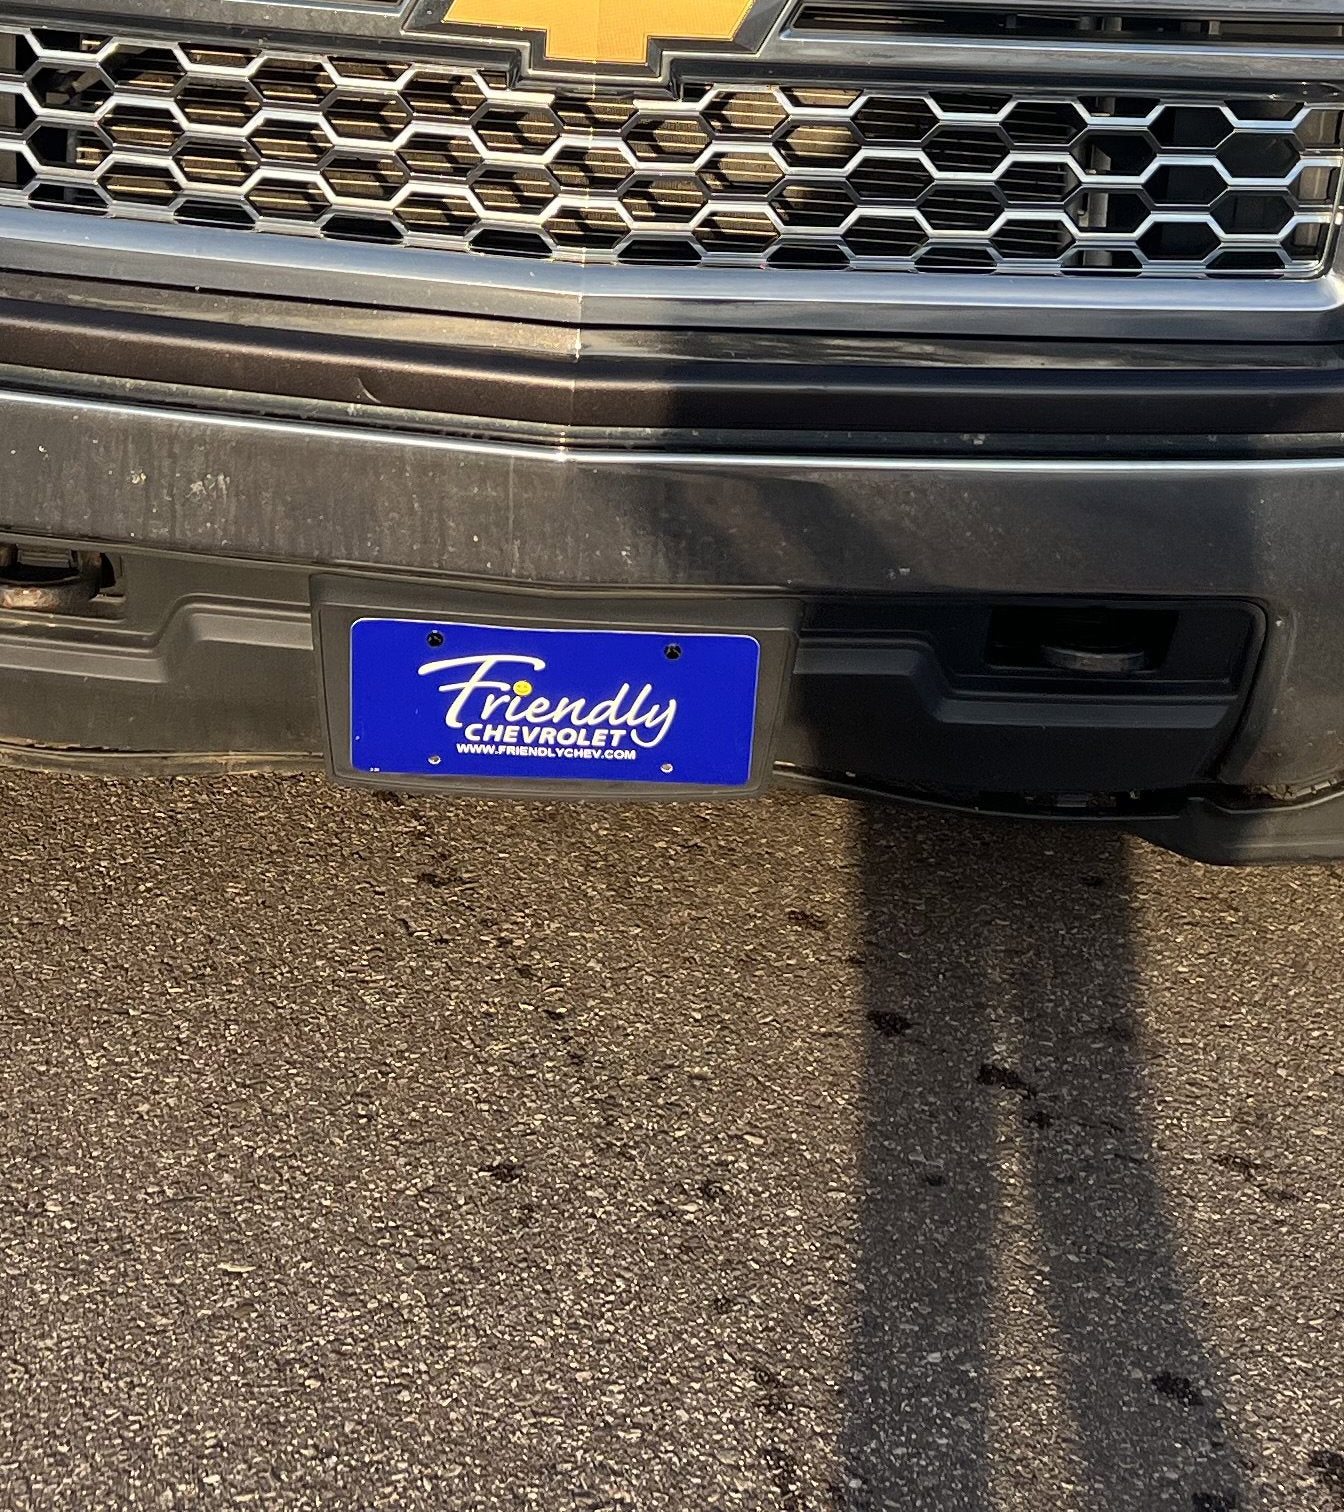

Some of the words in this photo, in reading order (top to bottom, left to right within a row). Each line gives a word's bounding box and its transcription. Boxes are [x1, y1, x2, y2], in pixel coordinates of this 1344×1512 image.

[417, 654, 677, 748] Friendly
[464, 723, 627, 747] CHEVROLET
[456, 743, 637, 761] WWW.FRIENDLYCHEV.COM
